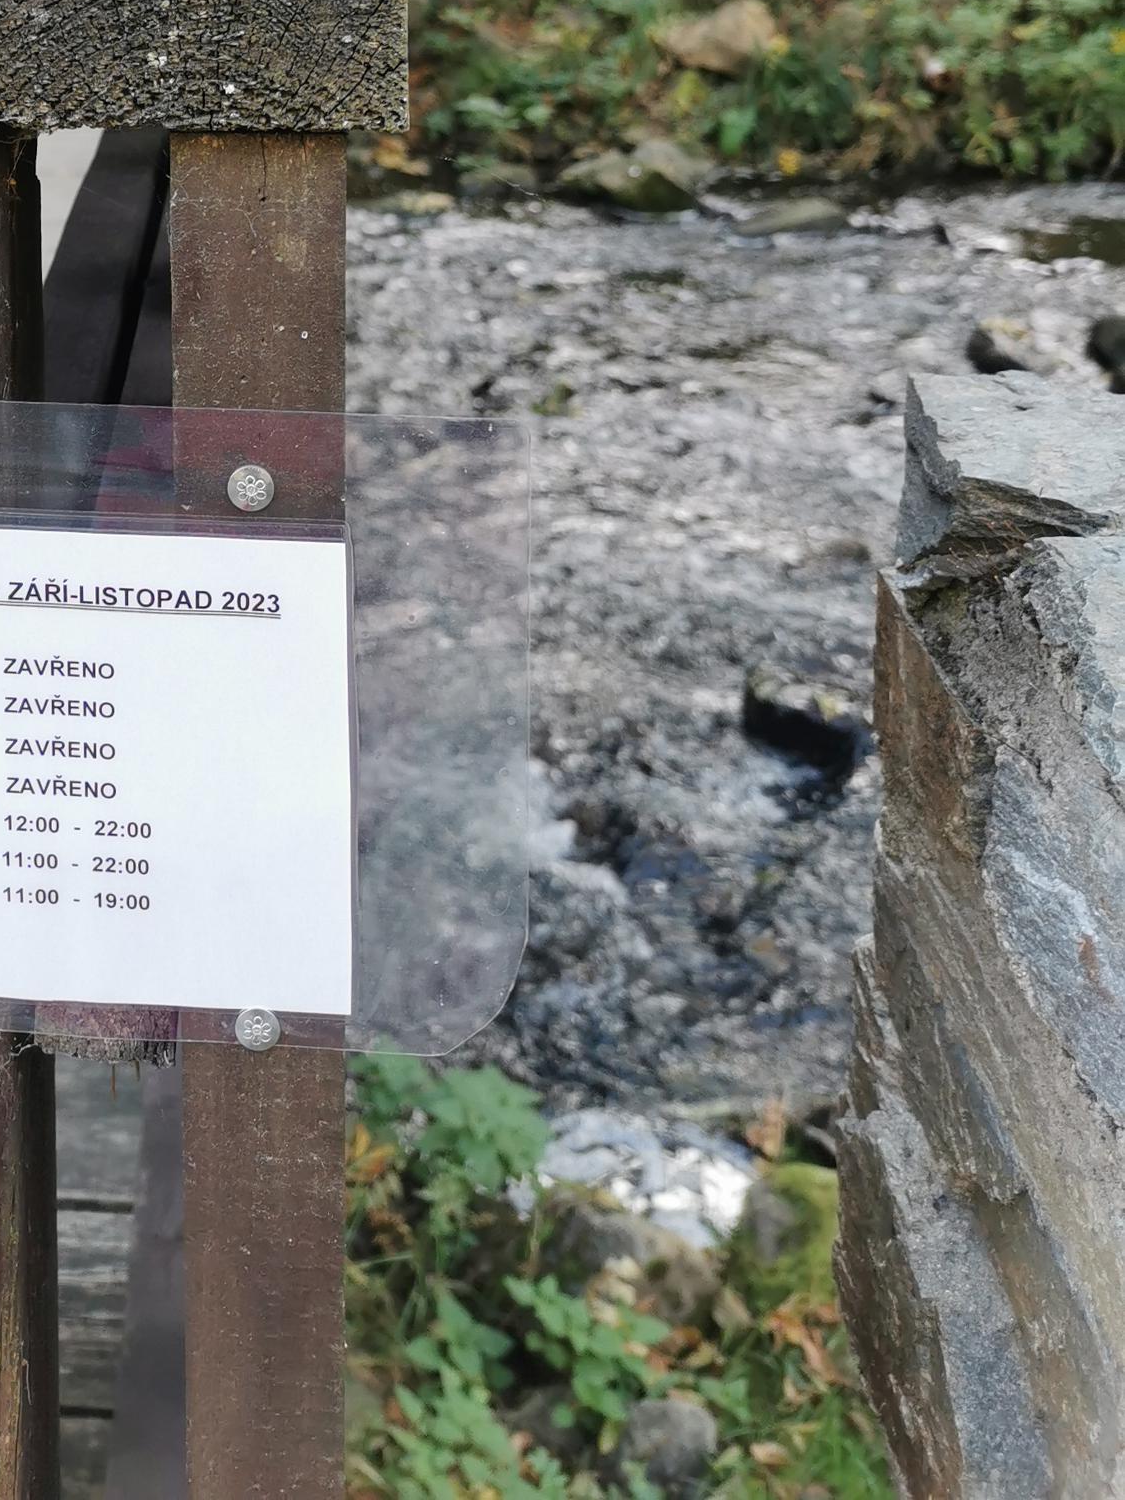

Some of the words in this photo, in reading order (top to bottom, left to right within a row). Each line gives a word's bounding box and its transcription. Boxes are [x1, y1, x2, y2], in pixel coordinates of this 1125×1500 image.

[7, 580, 213, 611] ZÁŘÍ-LISTOPAD
[221, 591, 281, 614] 2023
[3, 655, 115, 680] ZAVŘENO
[3, 694, 116, 719] ZAVŘENO
[4, 735, 116, 761] ZAVŘENO
[5, 774, 117, 800] ZAVŘENO
[3, 814, 60, 834] 12:00
[94, 819, 152, 839] 22:00
[2, 850, 59, 870] 11:00
[92, 856, 150, 876] 22:00
[2, 886, 60, 905] 11:00
[93, 892, 151, 911] 19:00
